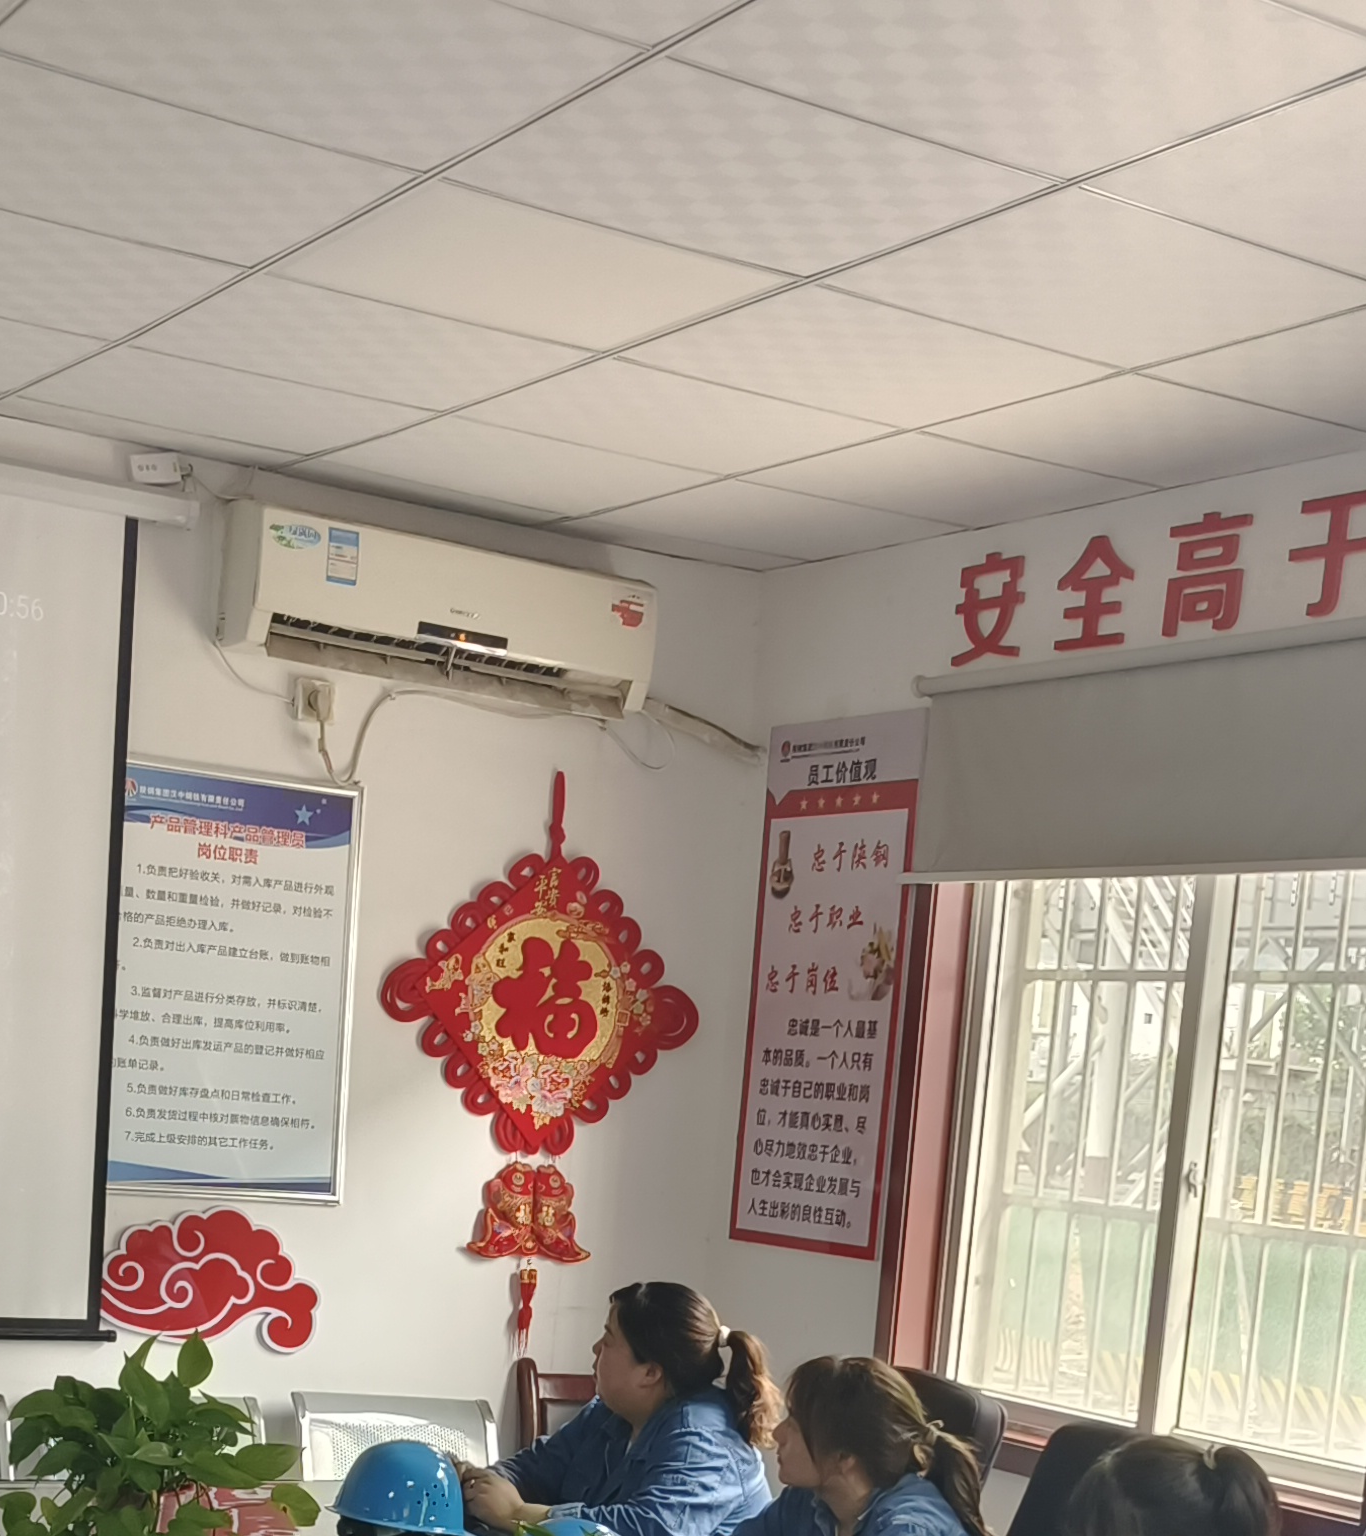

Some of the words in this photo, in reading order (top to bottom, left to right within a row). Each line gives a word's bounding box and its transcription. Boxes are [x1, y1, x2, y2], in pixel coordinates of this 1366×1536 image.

[807, 758, 878, 786] 员工价值观
[150, 814, 306, 849] 产品管理科产品管理员
[197, 843, 259, 865] 岗位职责
[811, 838, 889, 873] 忠于陕钢
[120, 885, 334, 919] 量、数量和重量检验，并做好记录，对检验不
[788, 904, 865, 934] 忠于职业
[765, 962, 839, 994] 忠于岗位
[491, 935, 599, 1060] 福
[787, 1018, 878, 1040] 忠诚是一个人最基
[762, 1047, 874, 1072] 本的品质。一个人只有
[759, 1078, 871, 1103] 忠诚于自己的职业和岗
[756, 1108, 867, 1135] 位，才能真心实意、尽
[753, 1138, 859, 1166] 心尽力地效忠于企业，
[751, 1168, 861, 1198] 也才会实现企业发展与
[747, 1197, 852, 1229] 人生出彩的良性互动。
